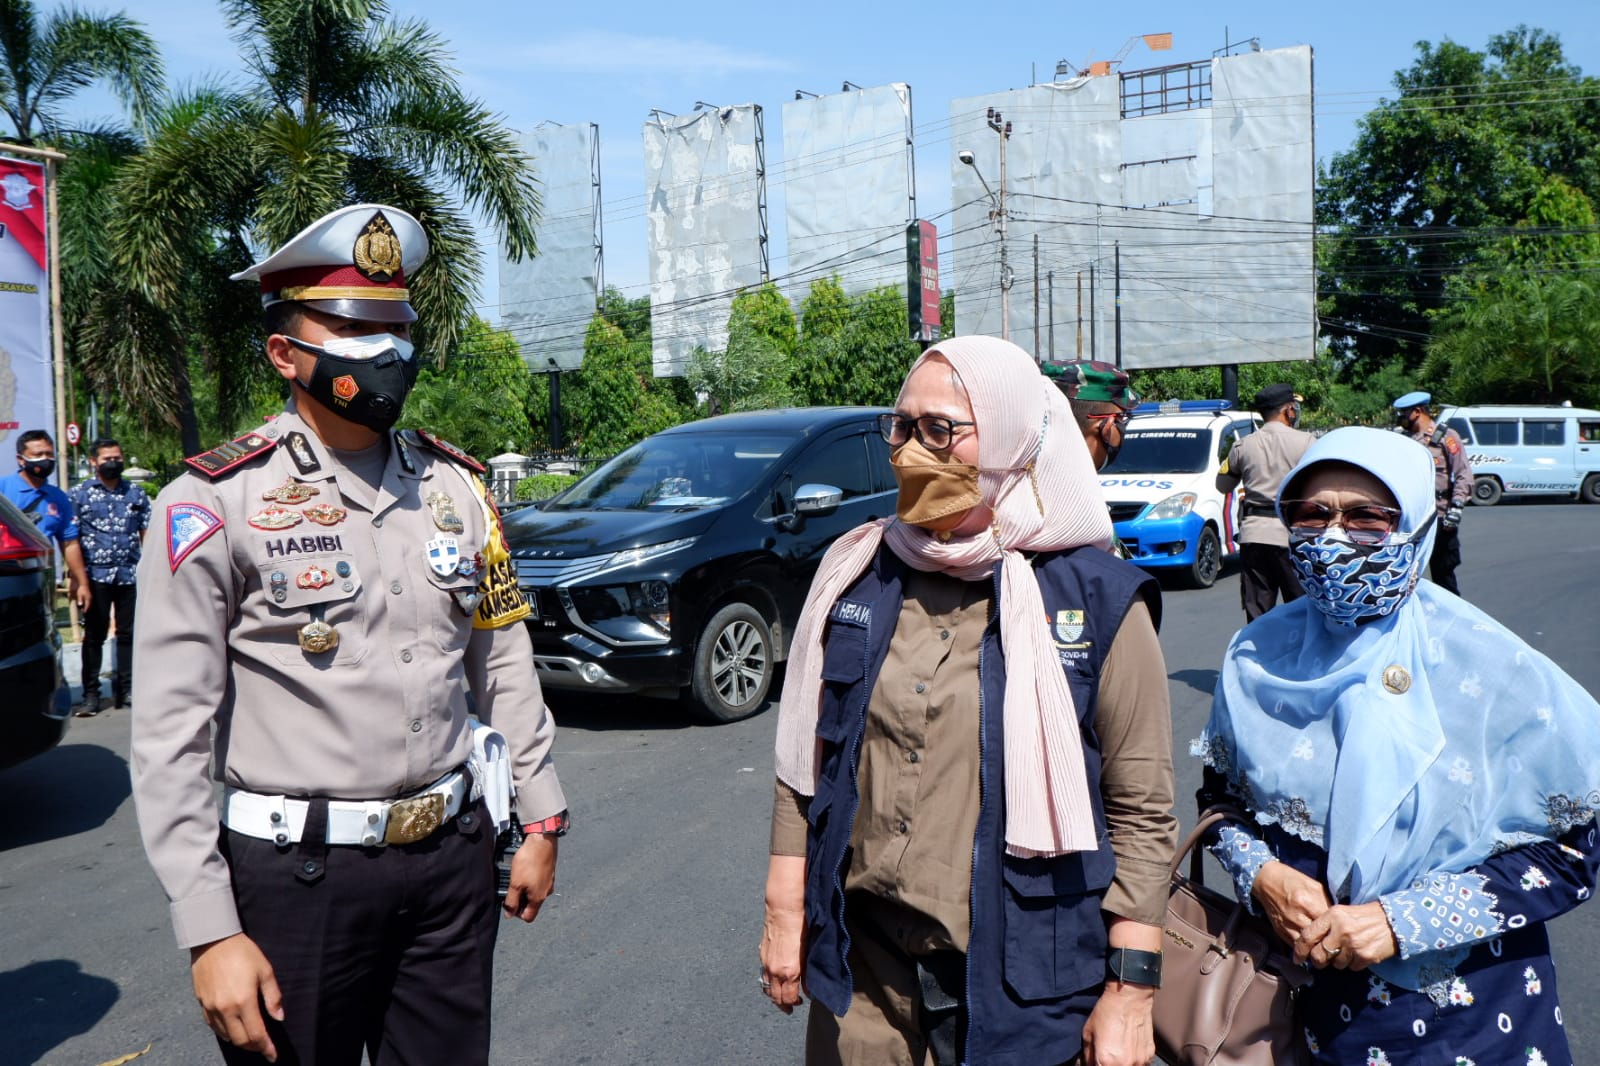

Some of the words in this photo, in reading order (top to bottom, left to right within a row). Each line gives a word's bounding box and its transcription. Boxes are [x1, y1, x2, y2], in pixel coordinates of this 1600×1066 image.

[1140, 431, 1176, 439] CIREBON
[1099, 479, 1174, 490] OVOS
[265, 534, 343, 558] HABIBI
